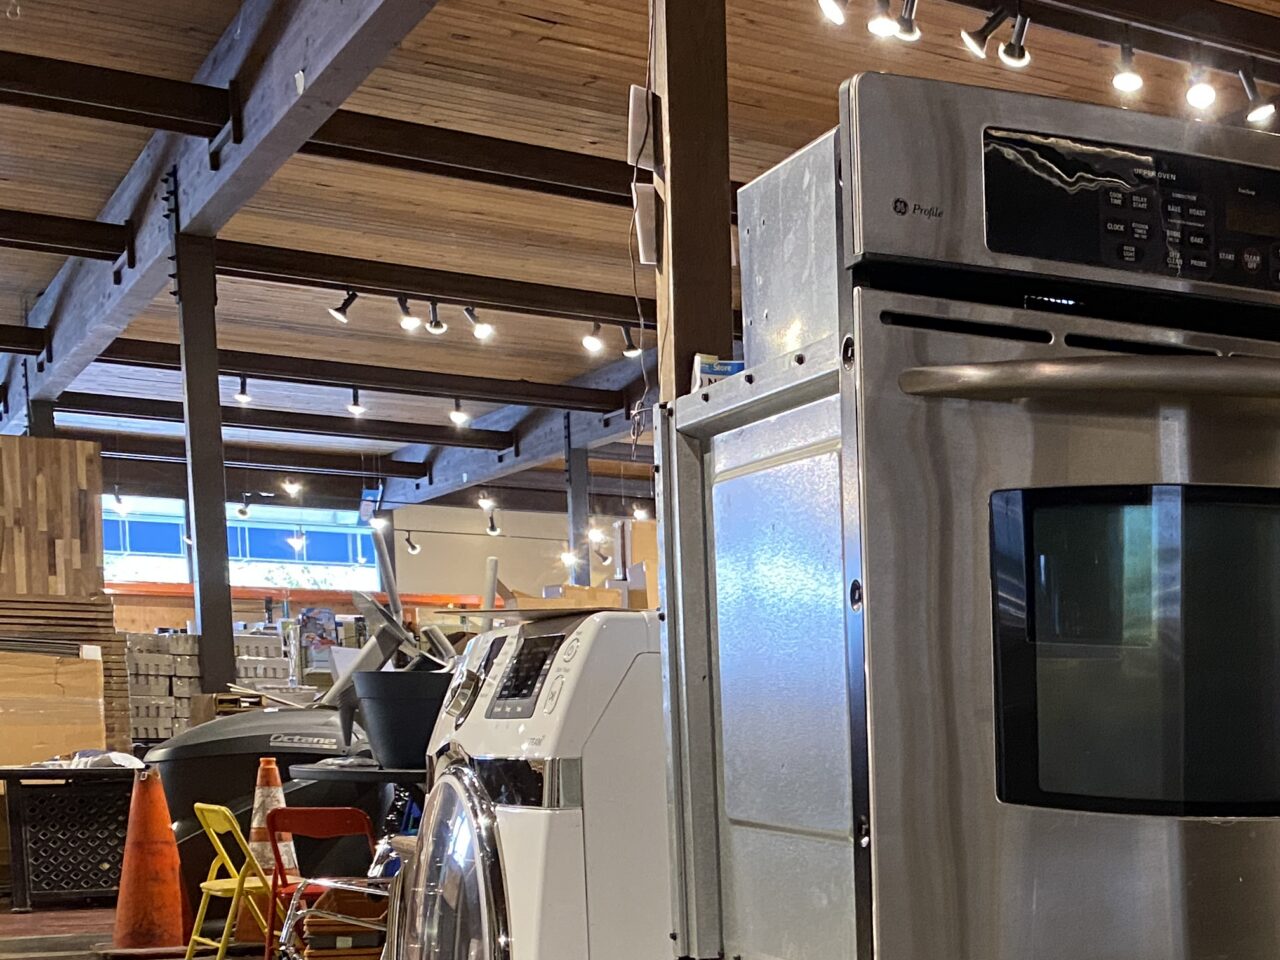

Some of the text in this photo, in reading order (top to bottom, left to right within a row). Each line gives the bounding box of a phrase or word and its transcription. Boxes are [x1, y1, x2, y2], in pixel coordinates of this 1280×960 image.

[1157, 171, 1176, 181] OVEN
[912, 203, 944, 219] Profile
[1106, 222, 1125, 232] CLOCK
[1219, 252, 1235, 262] START
[270, 733, 337, 745] Octane
